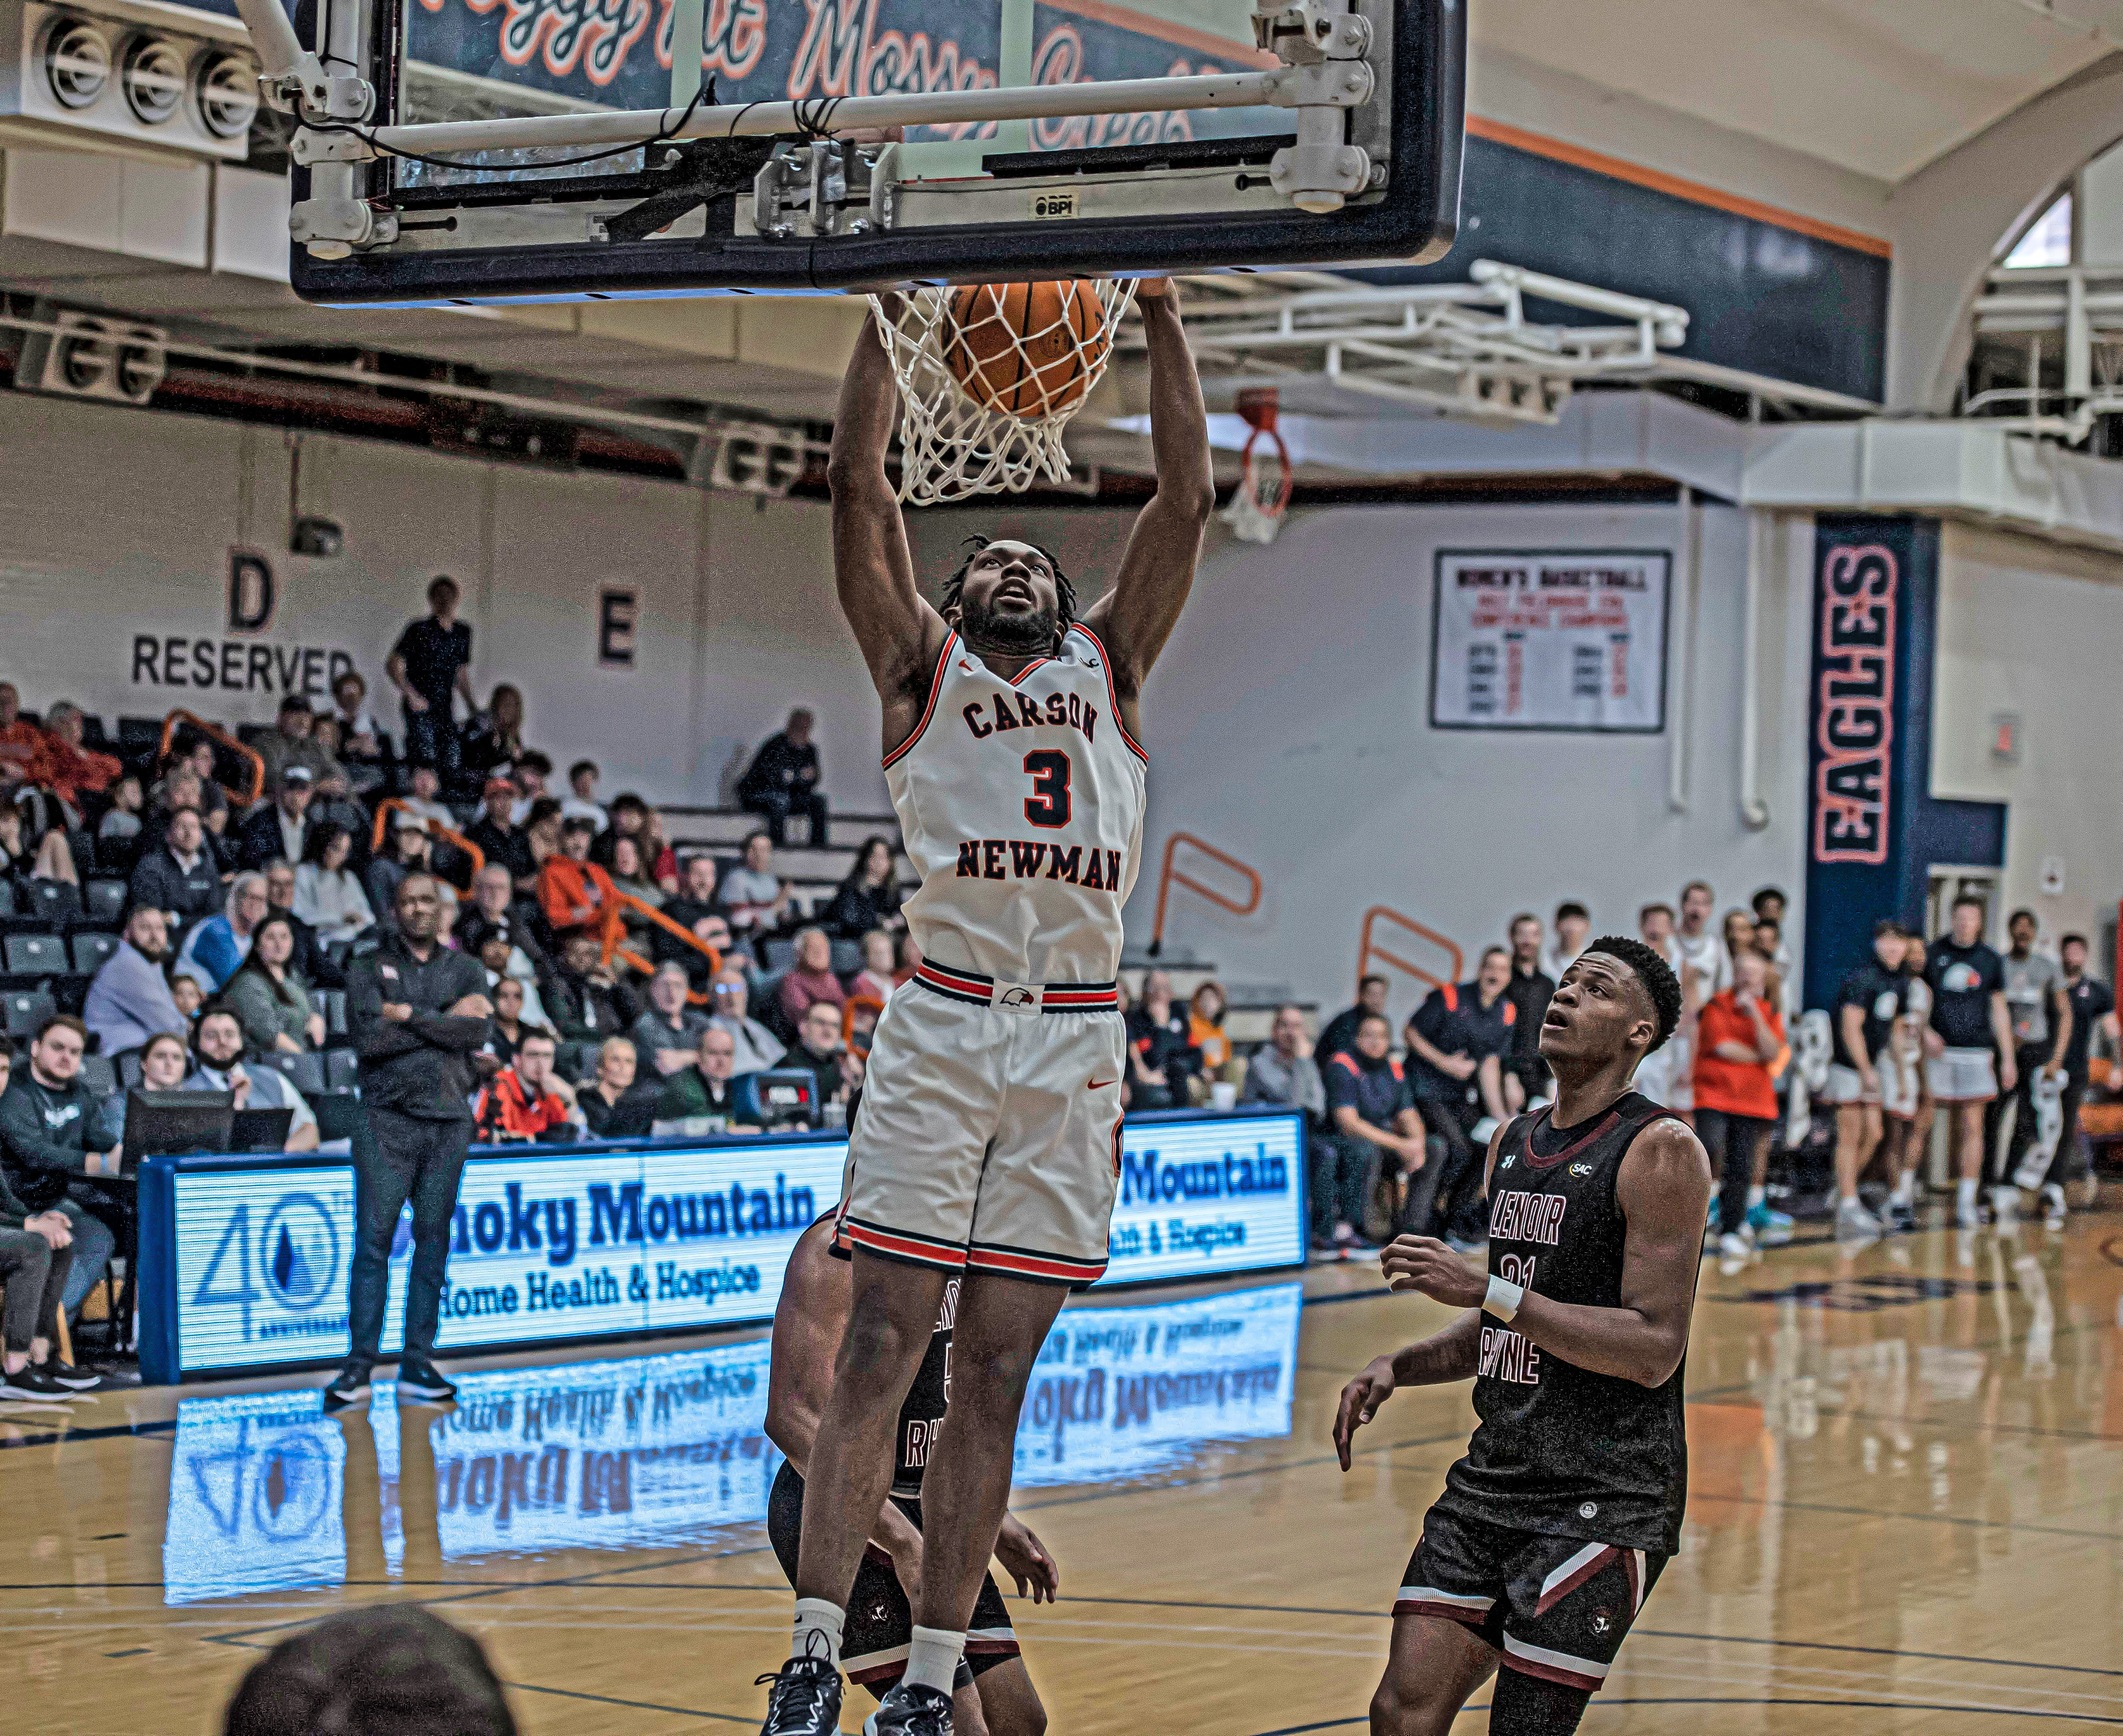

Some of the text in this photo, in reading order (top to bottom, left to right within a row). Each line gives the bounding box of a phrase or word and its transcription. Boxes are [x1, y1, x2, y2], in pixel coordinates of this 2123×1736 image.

[1048, 200, 1072, 215] BPI
[230, 555, 275, 628] D
[601, 592, 634, 663] E
[132, 635, 353, 695] RESERVED
[962, 691, 1098, 745] CARSON
[1816, 546, 1896, 862] EAGLES
[1023, 749, 1072, 829] 3
[956, 839, 1121, 892] NEWMAN
[1122, 1142, 1288, 1206] Mountain
[1572, 1163, 1593, 1176] SAC
[450, 1172, 814, 1266] oky Mountain
[1489, 1189, 1567, 1246] LENOIR
[439, 1258, 761, 1318] ome Health & Hospice
[1500, 1254, 1536, 1291] 21
